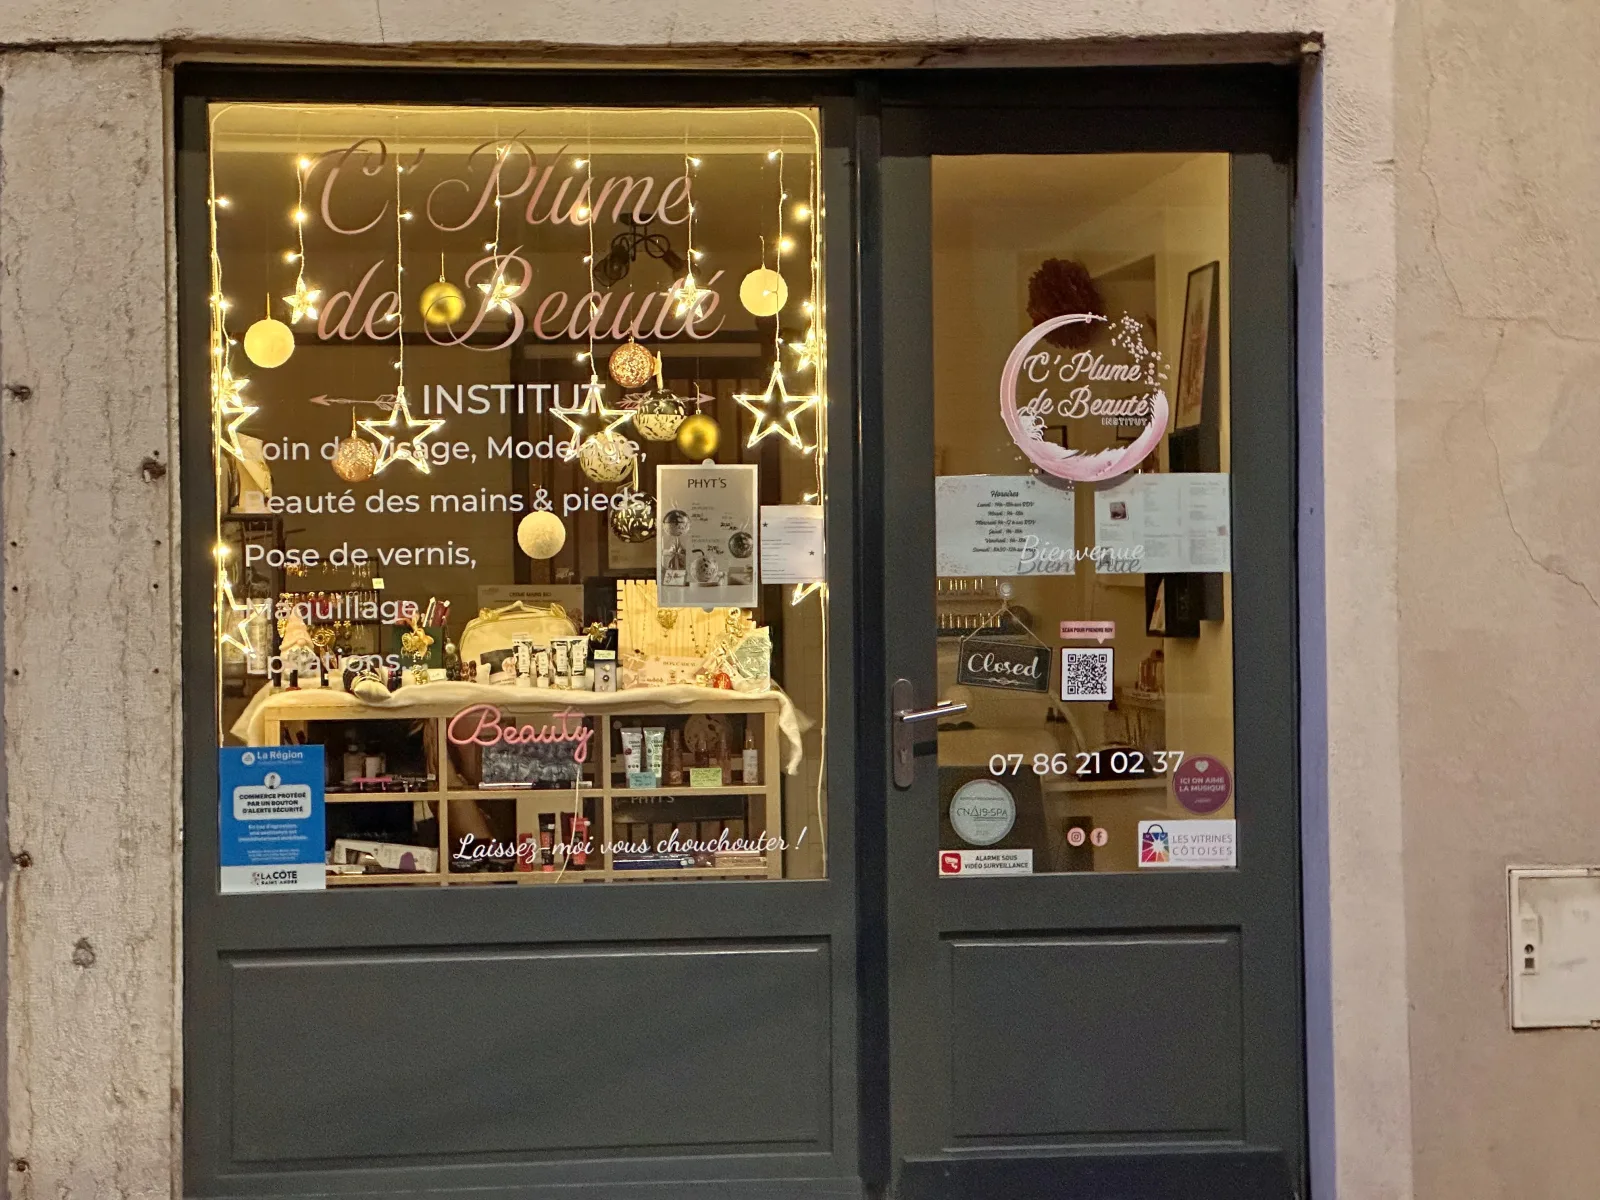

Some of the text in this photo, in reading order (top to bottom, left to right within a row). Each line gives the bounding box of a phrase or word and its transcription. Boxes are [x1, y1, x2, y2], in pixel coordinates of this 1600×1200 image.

[426, 129, 694, 232] Plume
[317, 245, 726, 351] de Beauté
[1059, 349, 1142, 382] Plume
[423, 383, 606, 414] INSTITUT
[1027, 384, 1150, 419] de Beauté
[1101, 417, 1148, 426] INSTITUT
[246, 436, 310, 460] oin
[487, 434, 647, 465] Modelge,
[687, 477, 727, 489] PHYT'S
[365, 488, 420, 513] des
[430, 487, 524, 513] mains
[532, 488, 553, 511] &
[245, 540, 476, 569] Pose de vernis,
[1019, 534, 1147, 565] Bienvenue
[967, 652, 1042, 680] Closed
[447, 704, 594, 764] Beauty
[257, 750, 303, 761] La Région
[988, 751, 1185, 777] 07 86 21 02 37
[277, 791, 306, 799] PROTÉGÉ
[1190, 784, 1226, 792] MUSIQUE
[453, 826, 808, 864] Laissez-moi vous chouchouter !
[1172, 834, 1232, 844] LES VITRINES
[1172, 845, 1232, 856] CÔTOISES
[261, 872, 270, 880] LA
